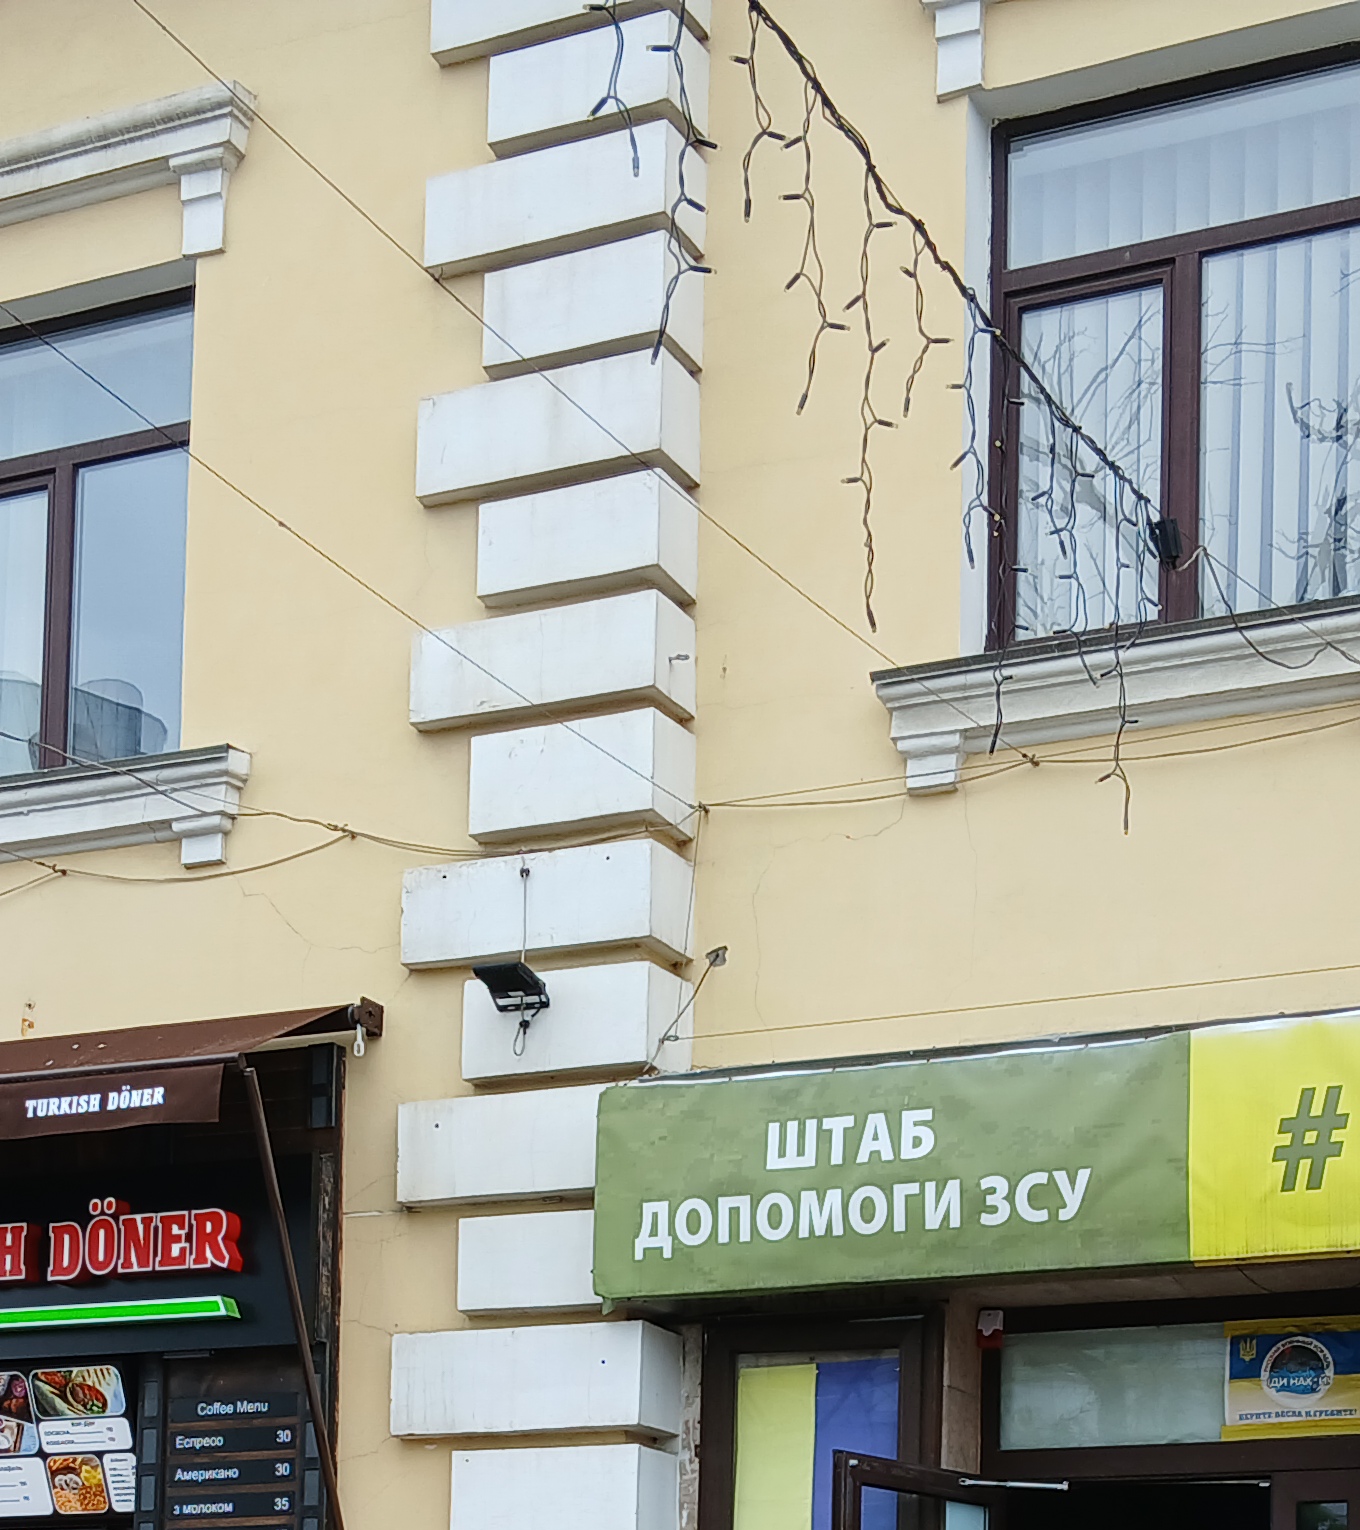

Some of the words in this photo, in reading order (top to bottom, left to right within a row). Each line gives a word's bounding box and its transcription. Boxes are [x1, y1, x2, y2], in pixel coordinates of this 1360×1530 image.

[26, 1093, 101, 1119] TURKISH
[107, 1086, 165, 1113] DÖNER
[766, 1108, 936, 1171] ШТАБ
[633, 1178, 962, 1261] ДОПОМОГИ
[979, 1167, 1092, 1228] ЗСУ
[46, 1197, 234, 1283] DÖNER
[197, 1402, 234, 1416] Coffee
[237, 1401, 269, 1413] Menu
[276, 1430, 292, 1443] 30
[174, 1468, 239, 1483] Американо
[275, 1463, 291, 1476] 30
[173, 1505, 180, 1515] з
[183, 1502, 234, 1514] молоком
[274, 1498, 290, 1511] 35
